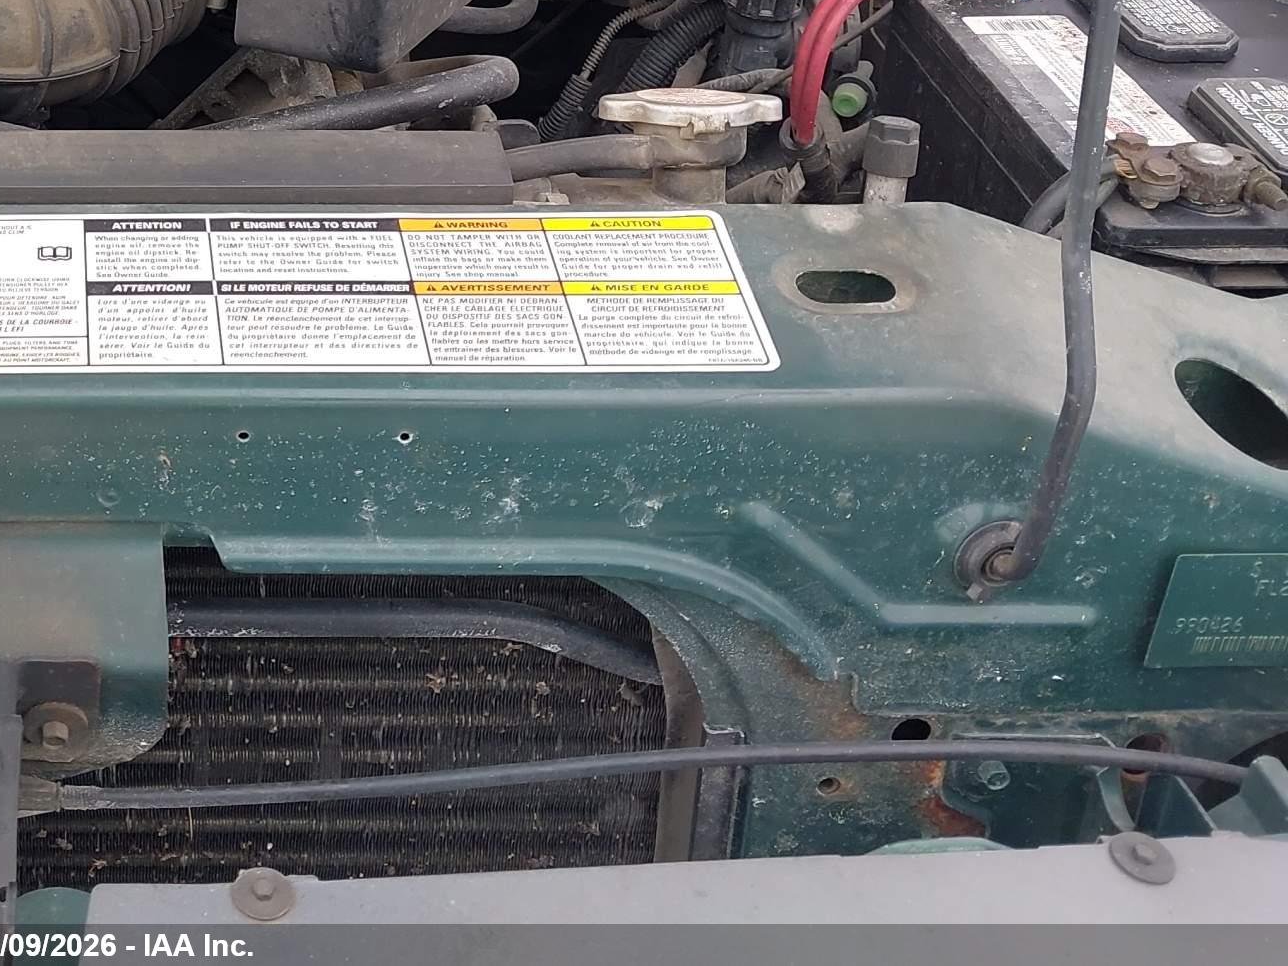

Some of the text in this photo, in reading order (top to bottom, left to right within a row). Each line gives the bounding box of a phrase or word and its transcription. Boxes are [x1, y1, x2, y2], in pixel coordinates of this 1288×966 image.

[1216, 87, 1253, 116] POISON
[112, 222, 182, 230] ATTENTION
[230, 221, 378, 229] IF ENGINE FAILS TO START
[112, 284, 192, 292] ATTENTION!
[221, 281, 410, 292] SI LE MOTEUR REFUSE DE DÉMARRER
